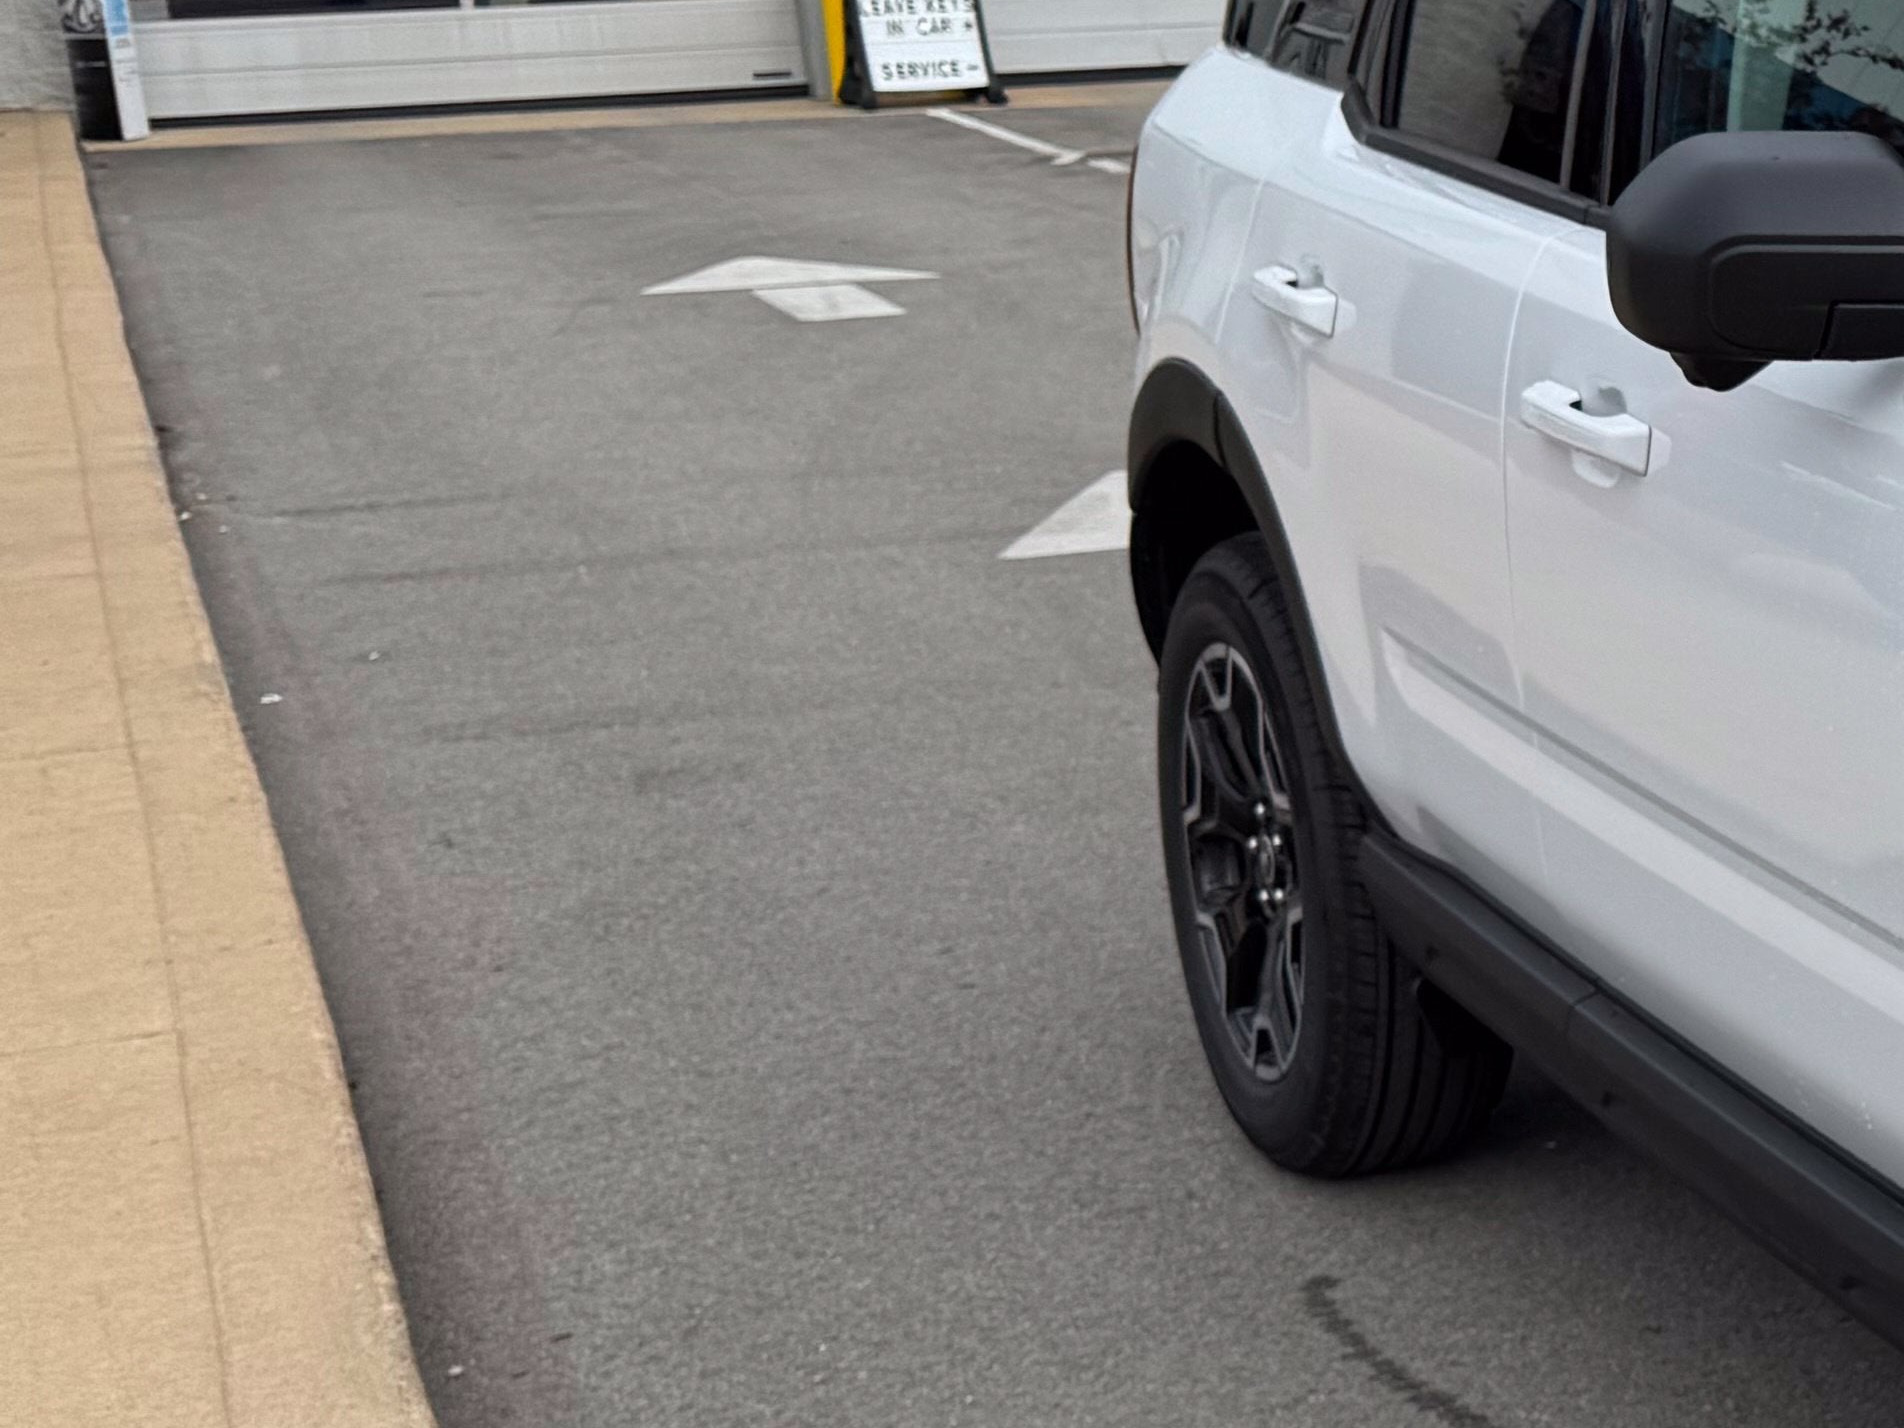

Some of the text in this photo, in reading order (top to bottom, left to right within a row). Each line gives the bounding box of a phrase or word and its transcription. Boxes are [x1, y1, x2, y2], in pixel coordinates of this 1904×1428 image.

[887, 18, 952, 36] IN CAR
[881, 60, 962, 80] SERVICE
